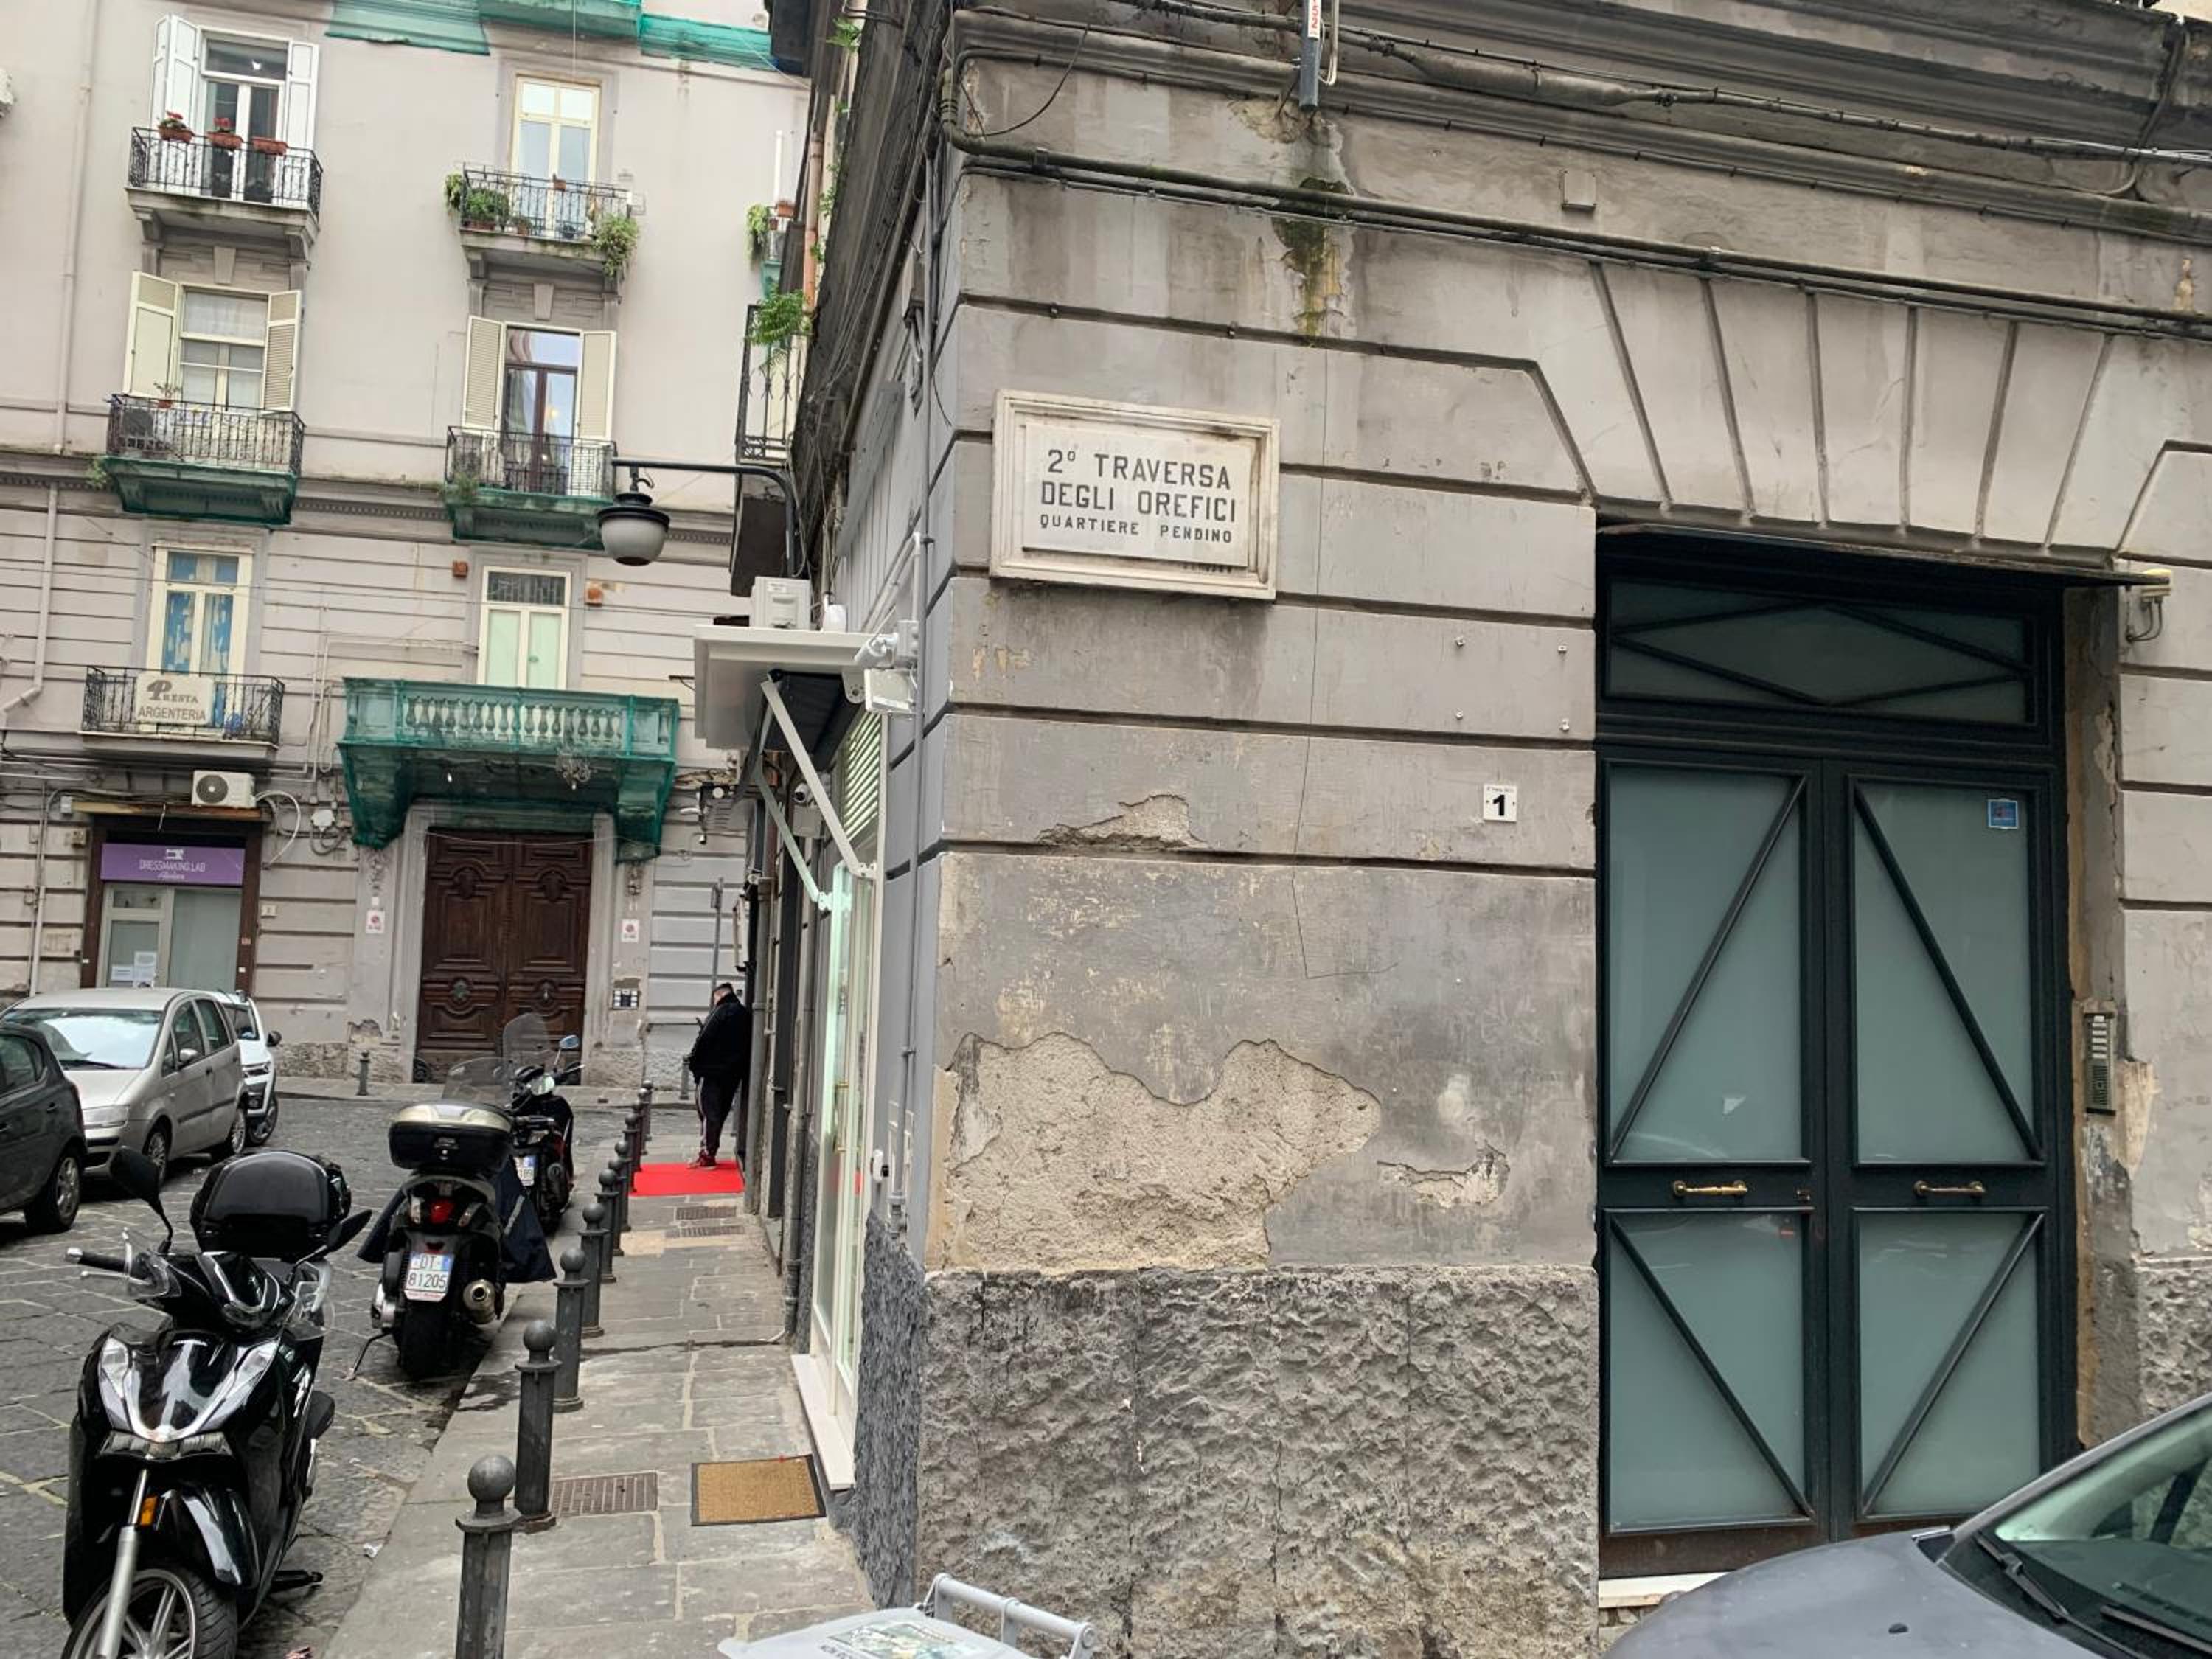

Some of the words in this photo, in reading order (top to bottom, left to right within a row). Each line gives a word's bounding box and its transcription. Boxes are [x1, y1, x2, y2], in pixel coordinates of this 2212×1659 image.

[1094, 453, 1231, 490] TRAVERSA
[1040, 481, 1114, 511] DEGLI
[1138, 490, 1236, 523] OREFICI
[1040, 514, 1139, 536] QUARTIERE
[1159, 524, 1232, 543] PENDINO
[138, 706, 206, 720] ARGENTERIA
[1492, 794, 1505, 816] 1
[139, 859, 190, 871] DRESSMAKING
[191, 861, 206, 872] LAB
[408, 1272, 447, 1289] 81205
